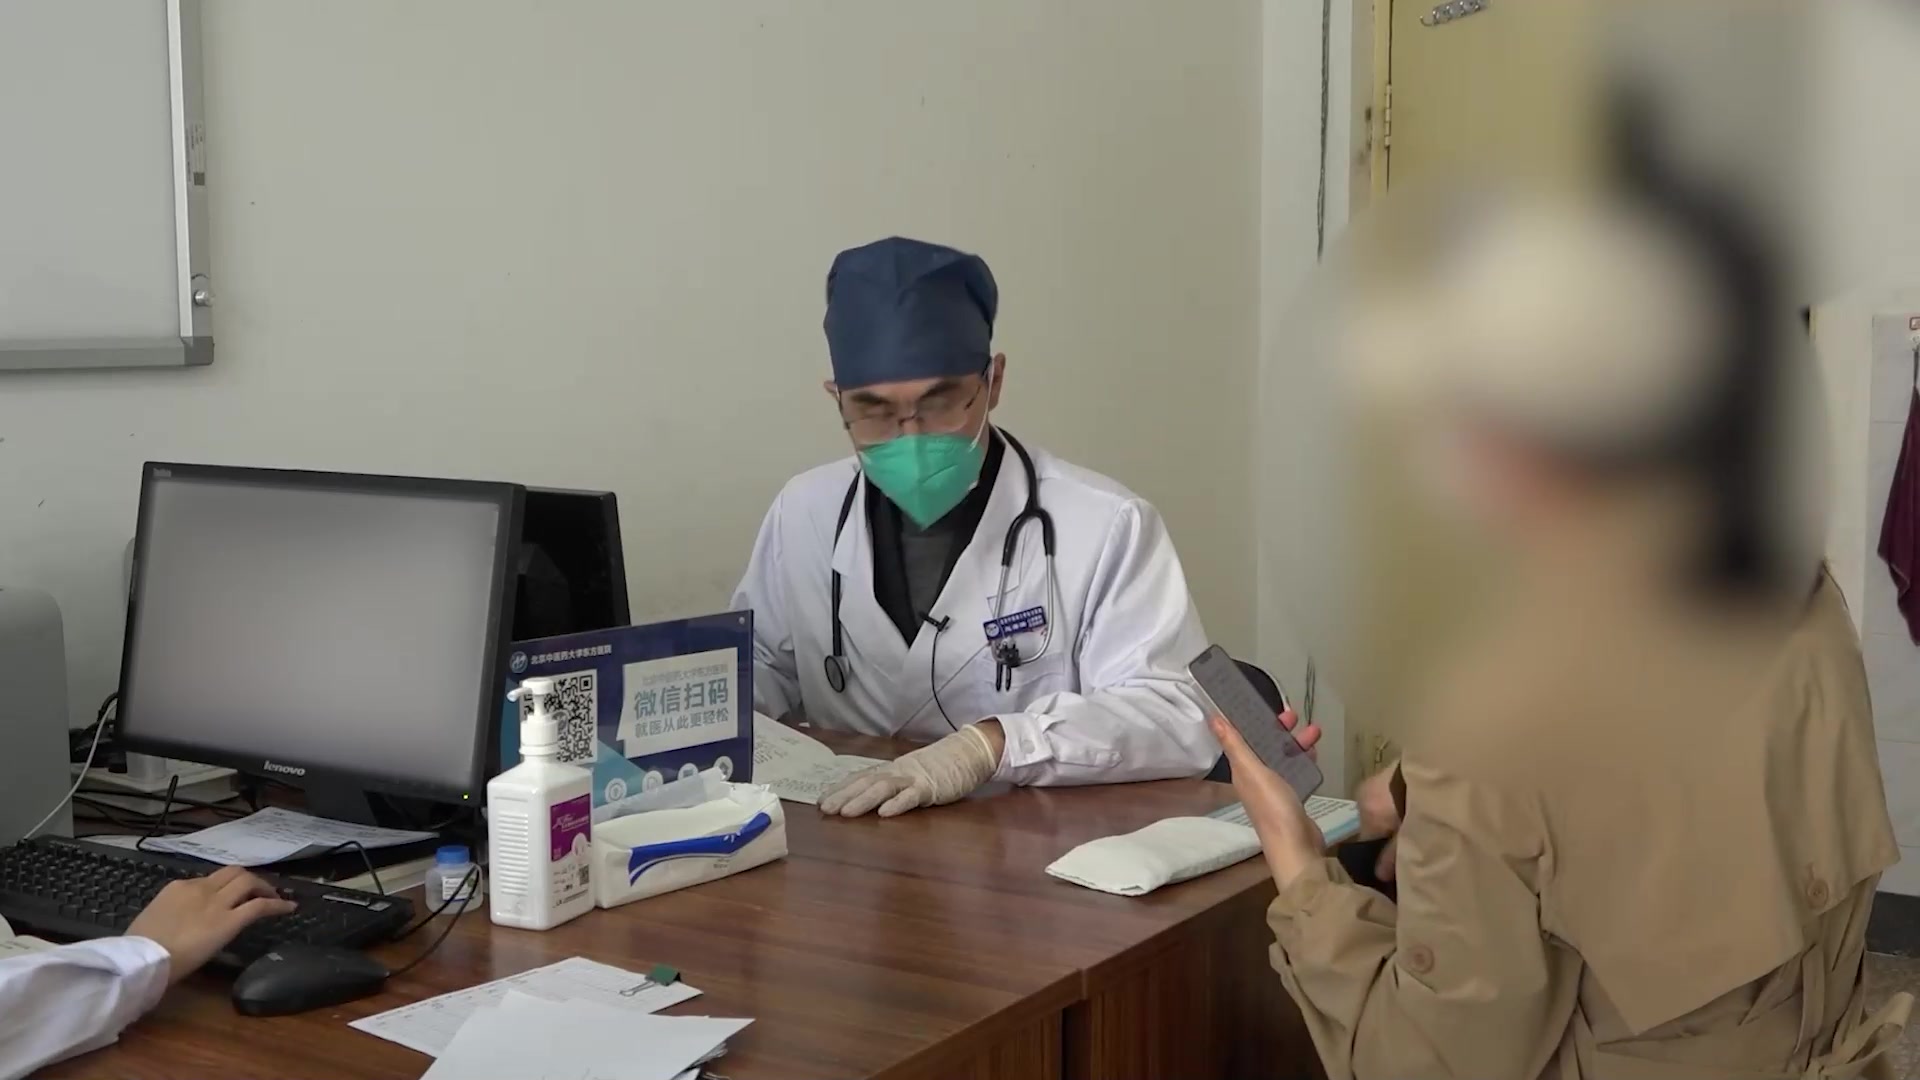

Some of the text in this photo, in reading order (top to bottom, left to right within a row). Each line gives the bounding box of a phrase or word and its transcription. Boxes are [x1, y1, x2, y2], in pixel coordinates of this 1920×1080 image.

[634, 677, 729, 720] 微信扫码
[635, 707, 729, 738] 就医从此更轻松
[263, 760, 306, 776] lenovo
